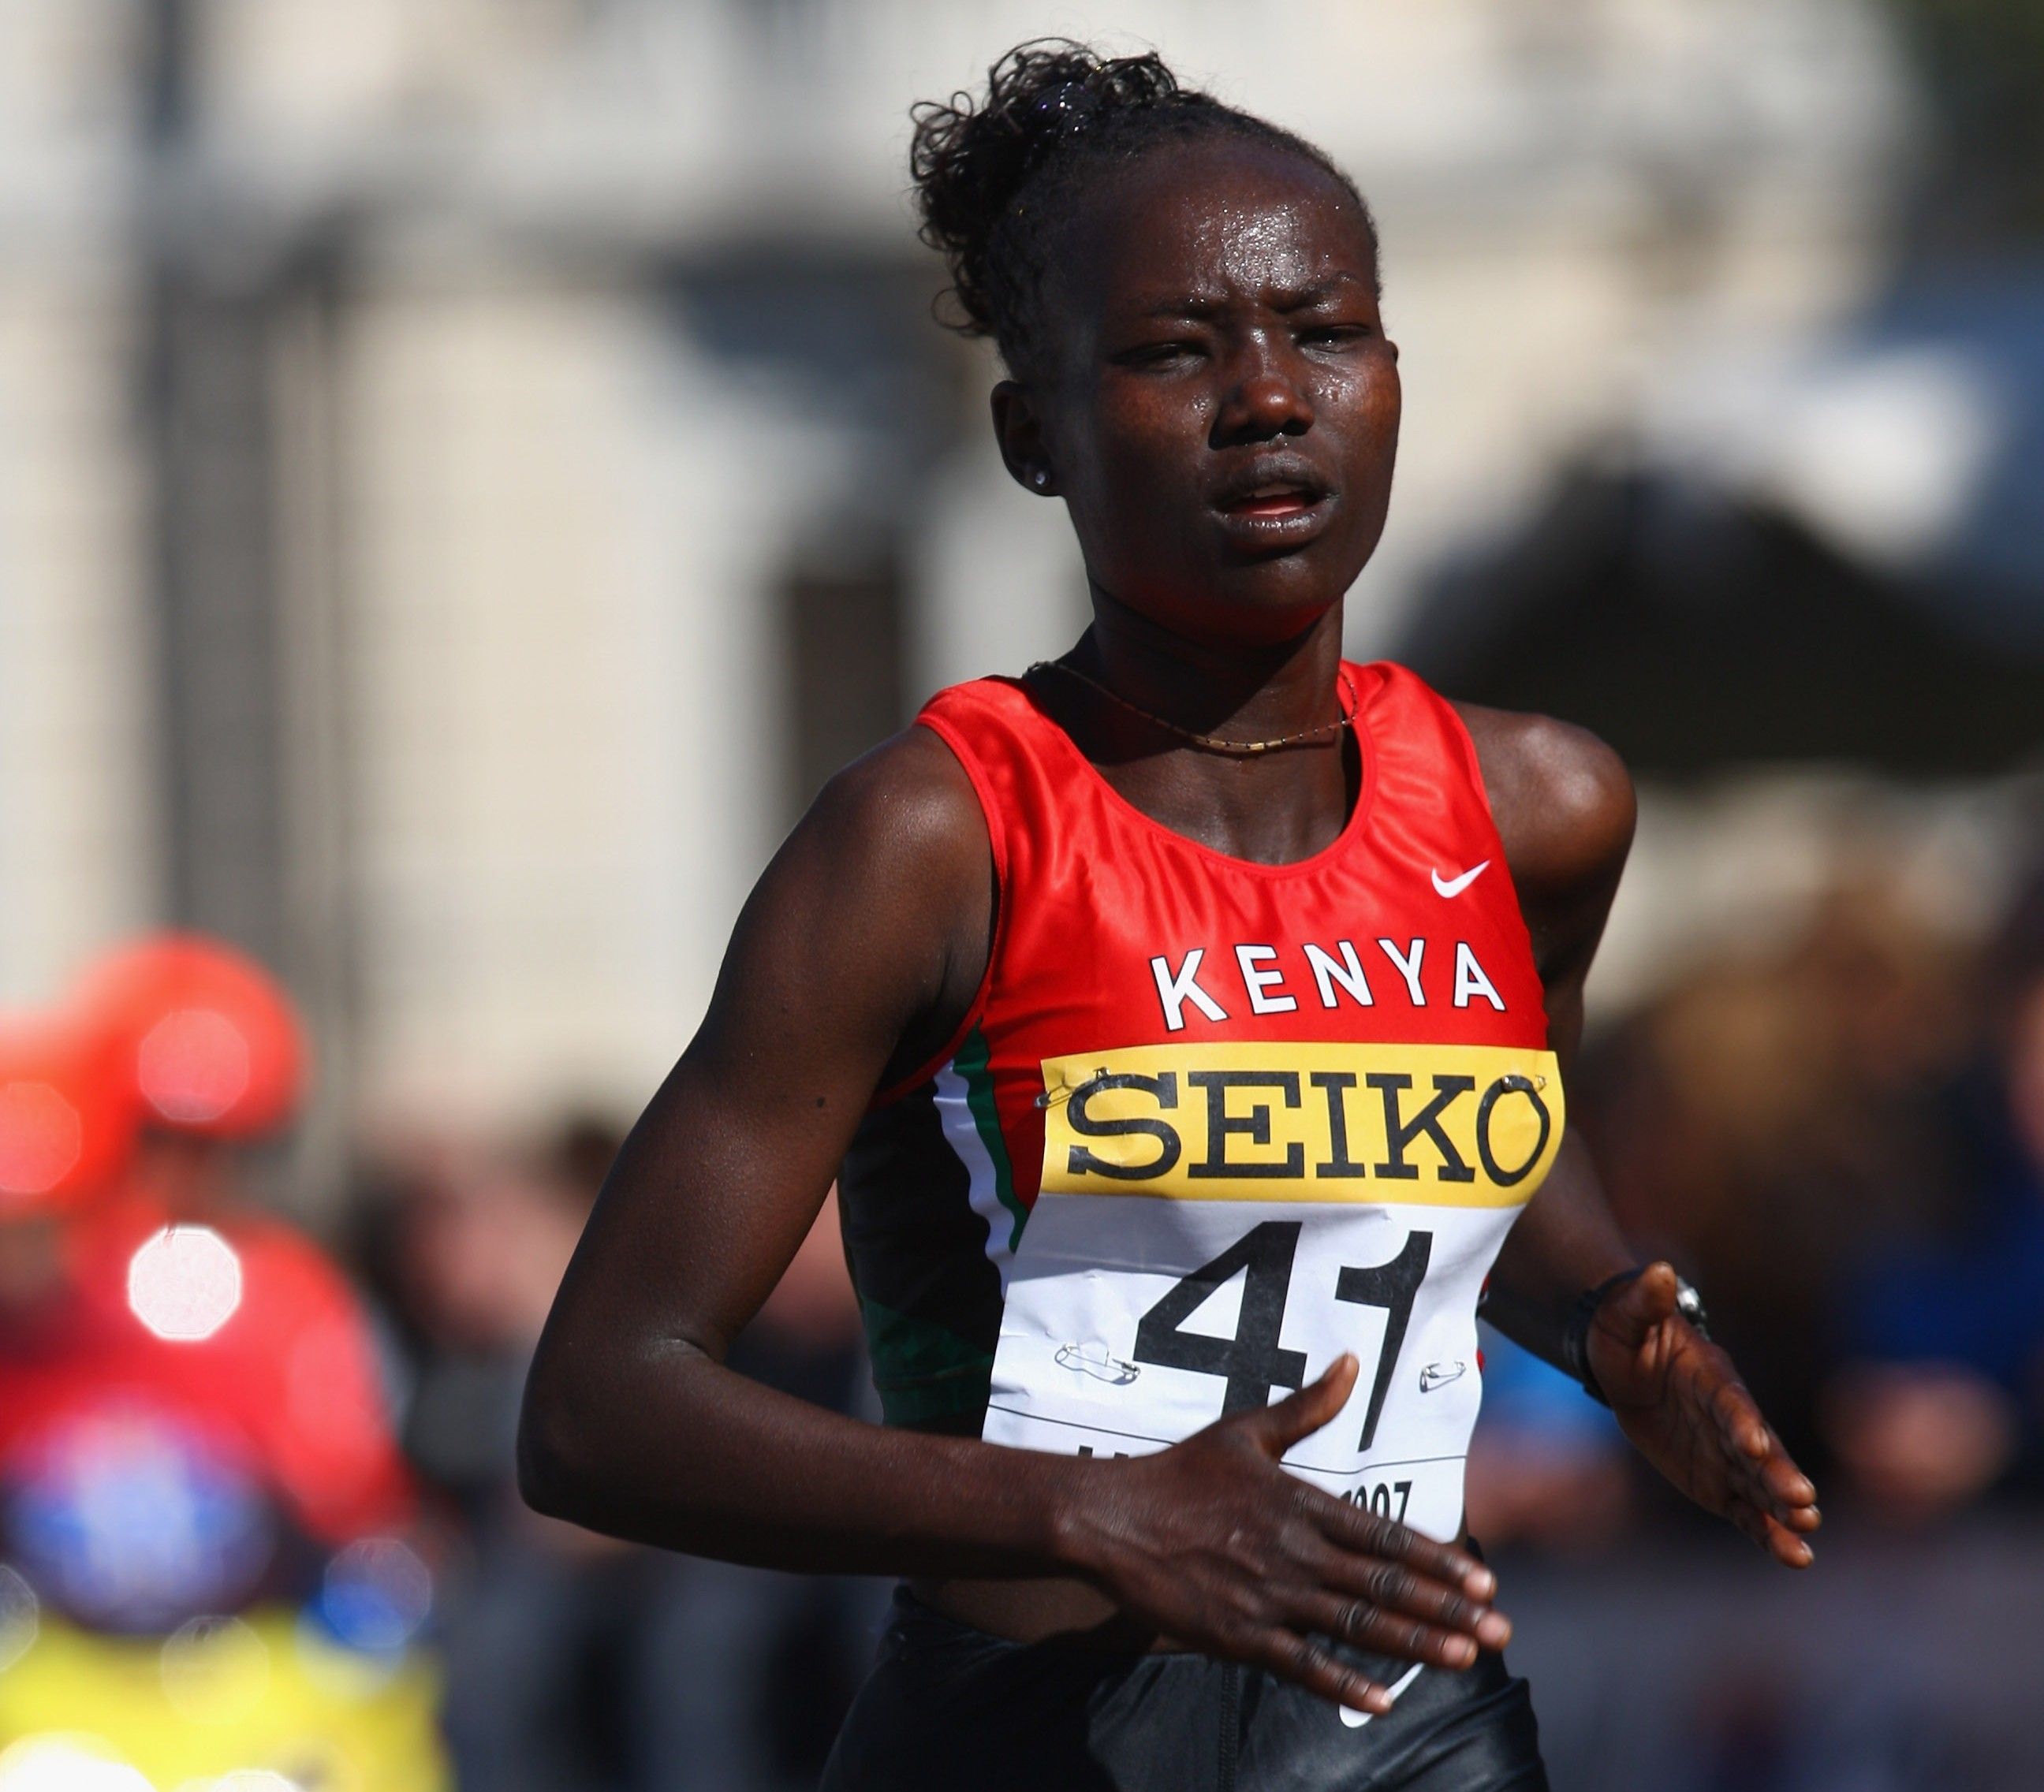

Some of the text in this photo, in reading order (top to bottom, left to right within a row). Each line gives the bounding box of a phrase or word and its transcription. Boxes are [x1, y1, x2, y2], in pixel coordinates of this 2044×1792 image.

[1151, 938, 1507, 1031] KENYA
[1067, 1071, 1551, 1187] SEIKO
[1133, 1221, 1434, 1452] 41
[1340, 1480, 1412, 1525] 007
